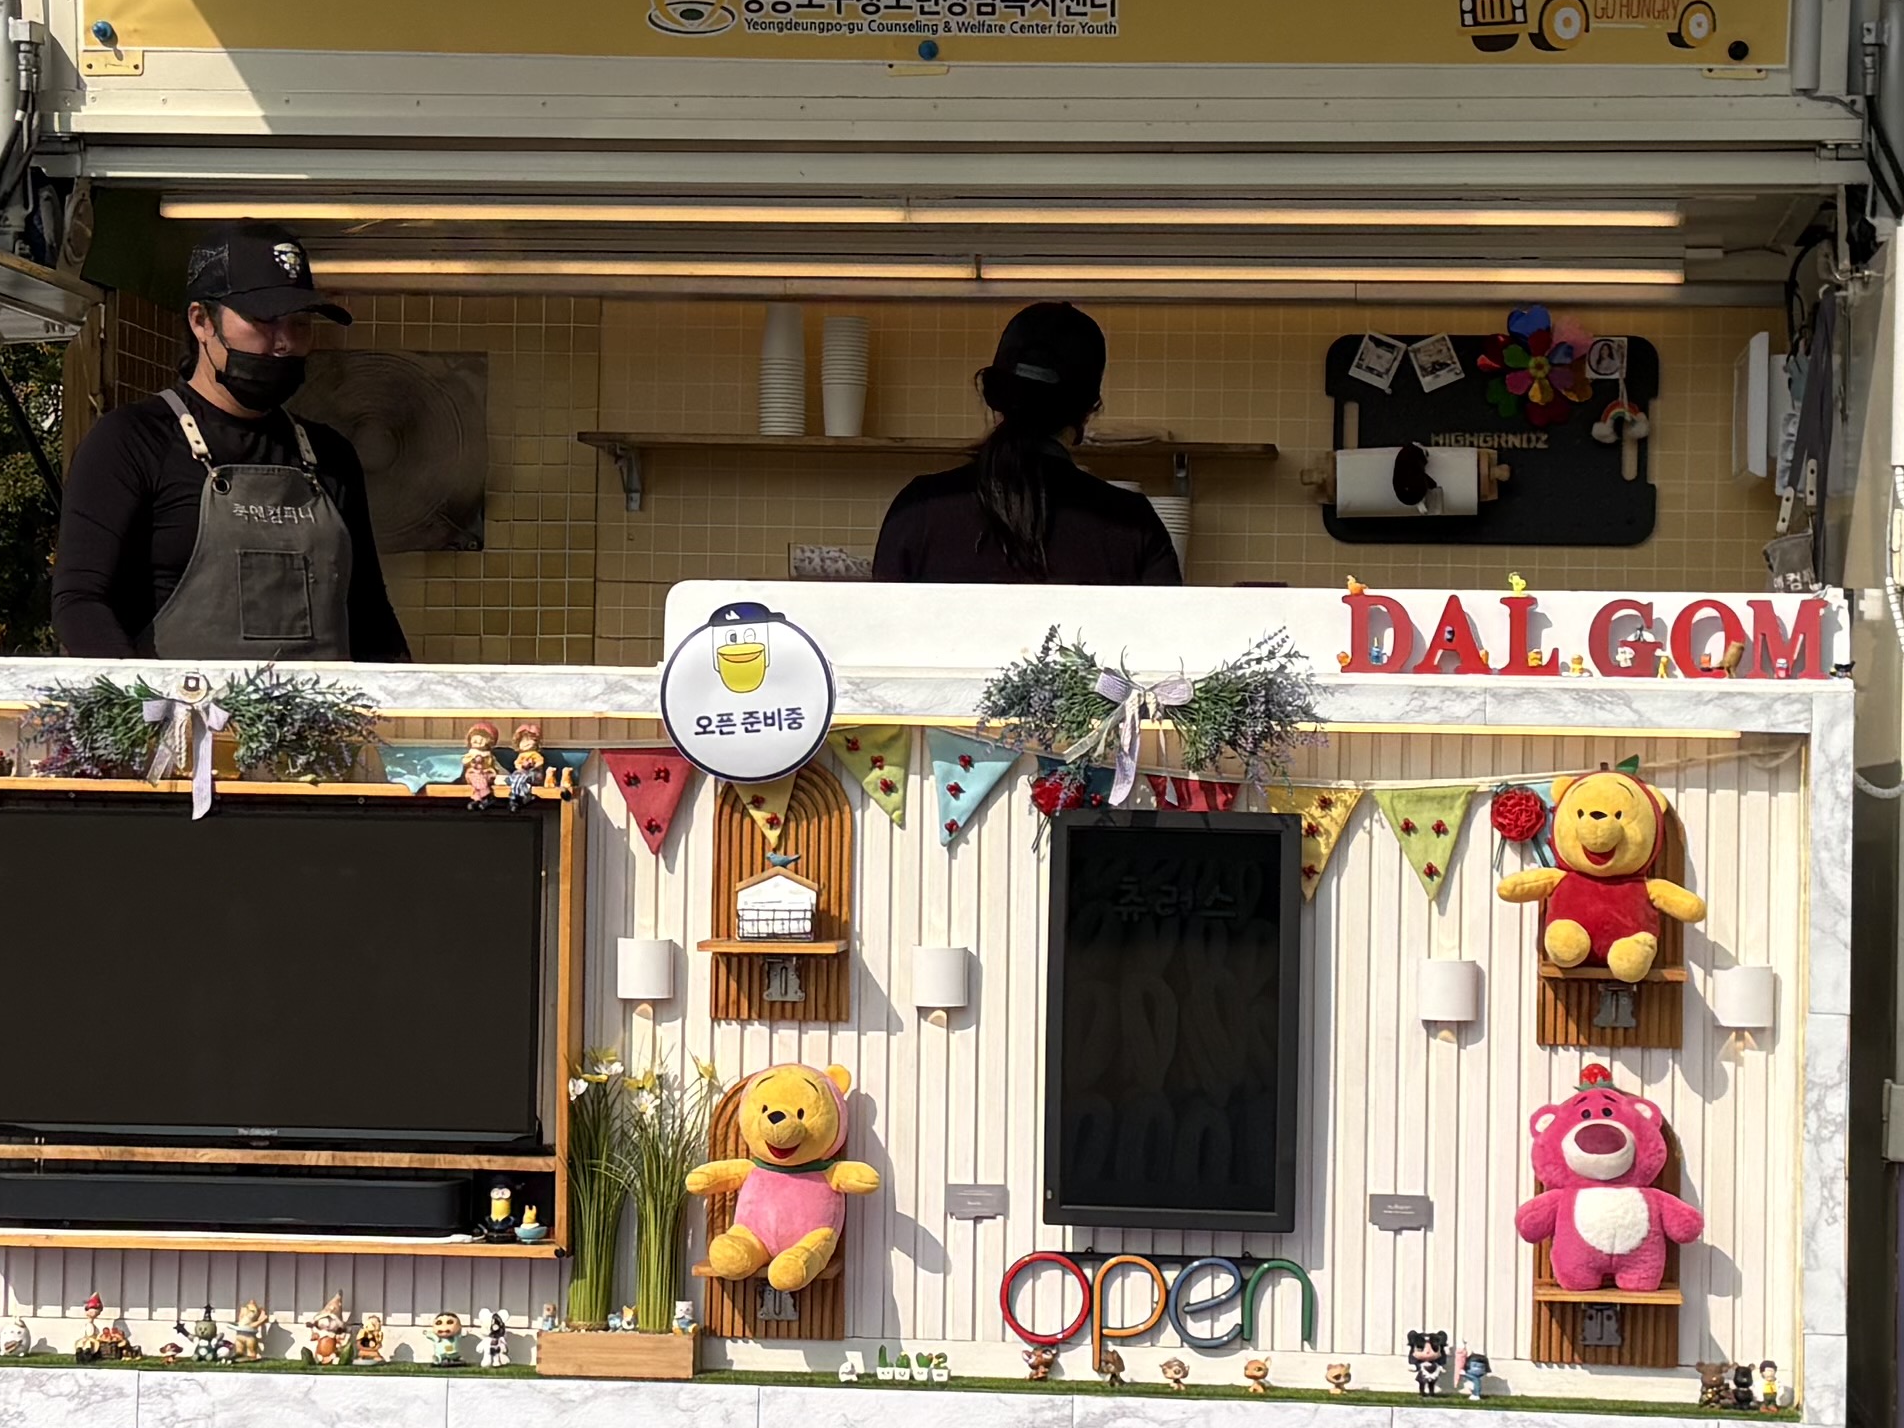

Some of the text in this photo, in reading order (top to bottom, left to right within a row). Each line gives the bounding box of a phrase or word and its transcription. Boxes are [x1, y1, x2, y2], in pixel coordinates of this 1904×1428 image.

[744, 18, 1118, 36] Yeongdeungpo-gu Counseling & Welfare Center for Youth
[1340, 593, 1832, 681] DAL GOM
[693, 706, 805, 736] 오픈 준비중
[1112, 873, 1237, 924] 츄러스
[999, 1249, 1315, 1373] open
